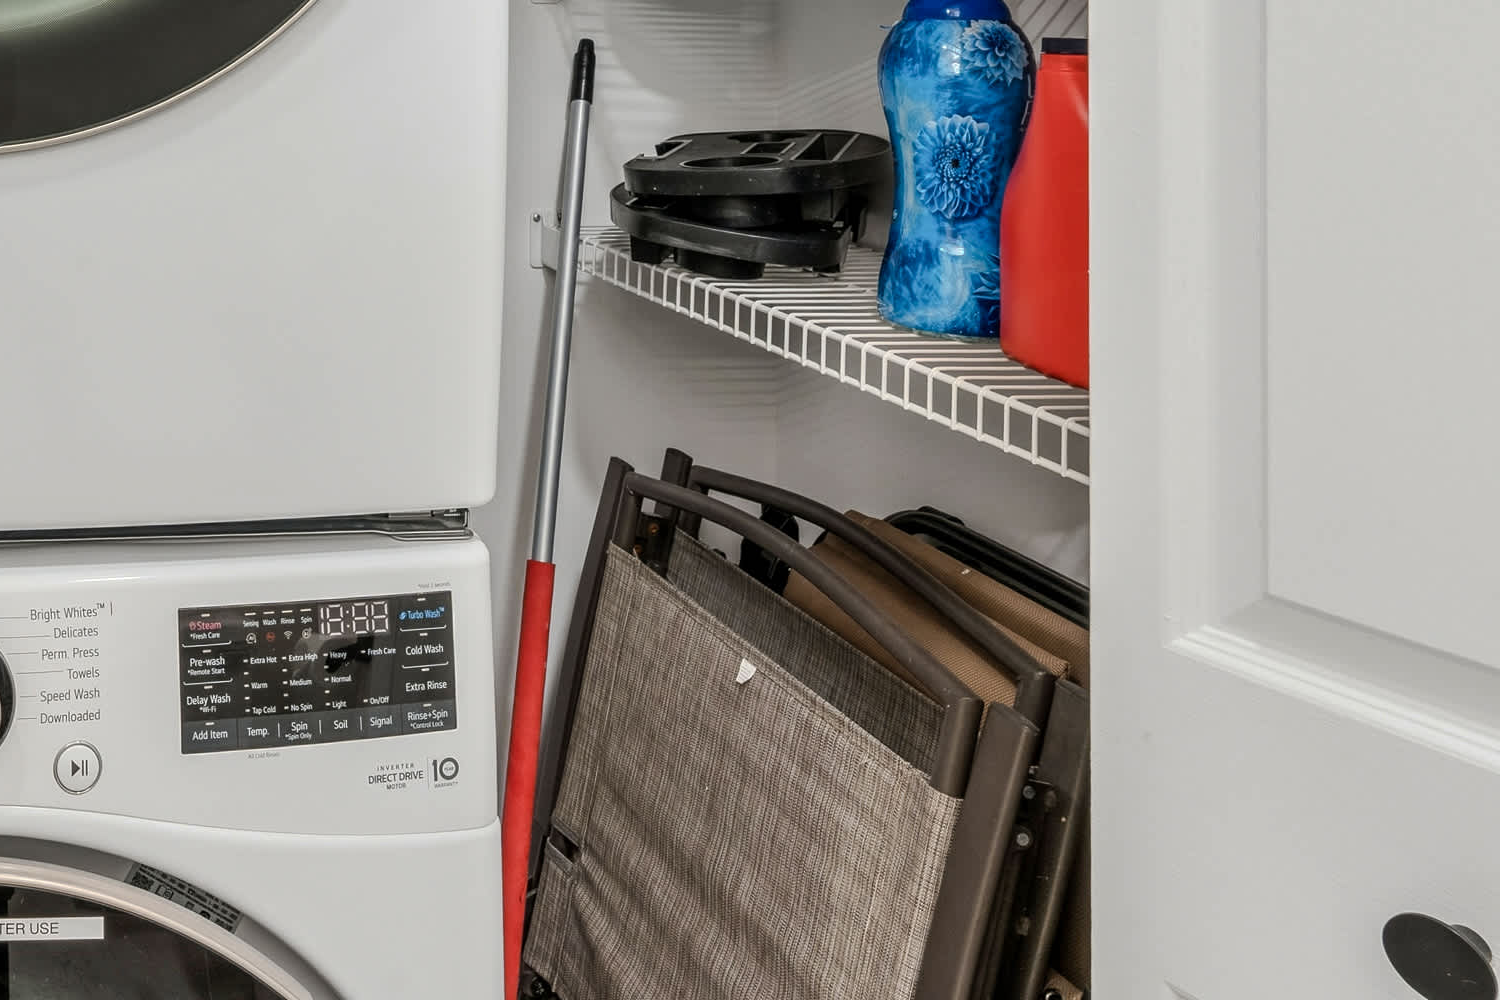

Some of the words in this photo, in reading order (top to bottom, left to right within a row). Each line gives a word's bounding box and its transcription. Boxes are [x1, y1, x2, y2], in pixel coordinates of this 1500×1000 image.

[30, 609, 60, 623] Bright
[407, 610, 423, 619] Turbo
[197, 621, 222, 630] Steam
[54, 626, 99, 639] Delicates
[73, 647, 100, 658] Press
[405, 645, 423, 655] Cold
[424, 644, 444, 654] Wash
[189, 656, 225, 667] Pre-wash
[67, 667, 100, 680] Towels
[405, 682, 425, 692] Extra
[427, 680, 448, 690] Rinse
[40, 690, 71, 704] Speed
[74, 687, 100, 700] Wash
[187, 695, 208, 706] Delay
[210, 693, 231, 703] Wash
[40, 710, 100, 724] Downloaded
[407, 709, 448, 721] Rinse+Spin
[291, 722, 308, 732] Spin
[333, 720, 348, 729] Soil
[370, 715, 393, 728] Signal
[192, 731, 208, 741] Add
[210, 730, 228, 739] Item
[377, 762, 414, 771] INVERTER
[432, 757, 459, 782] 10
[368, 773, 397, 785] DIRECT
[398, 770, 424, 781] DRIVE
[29, 922, 59, 934] USE
